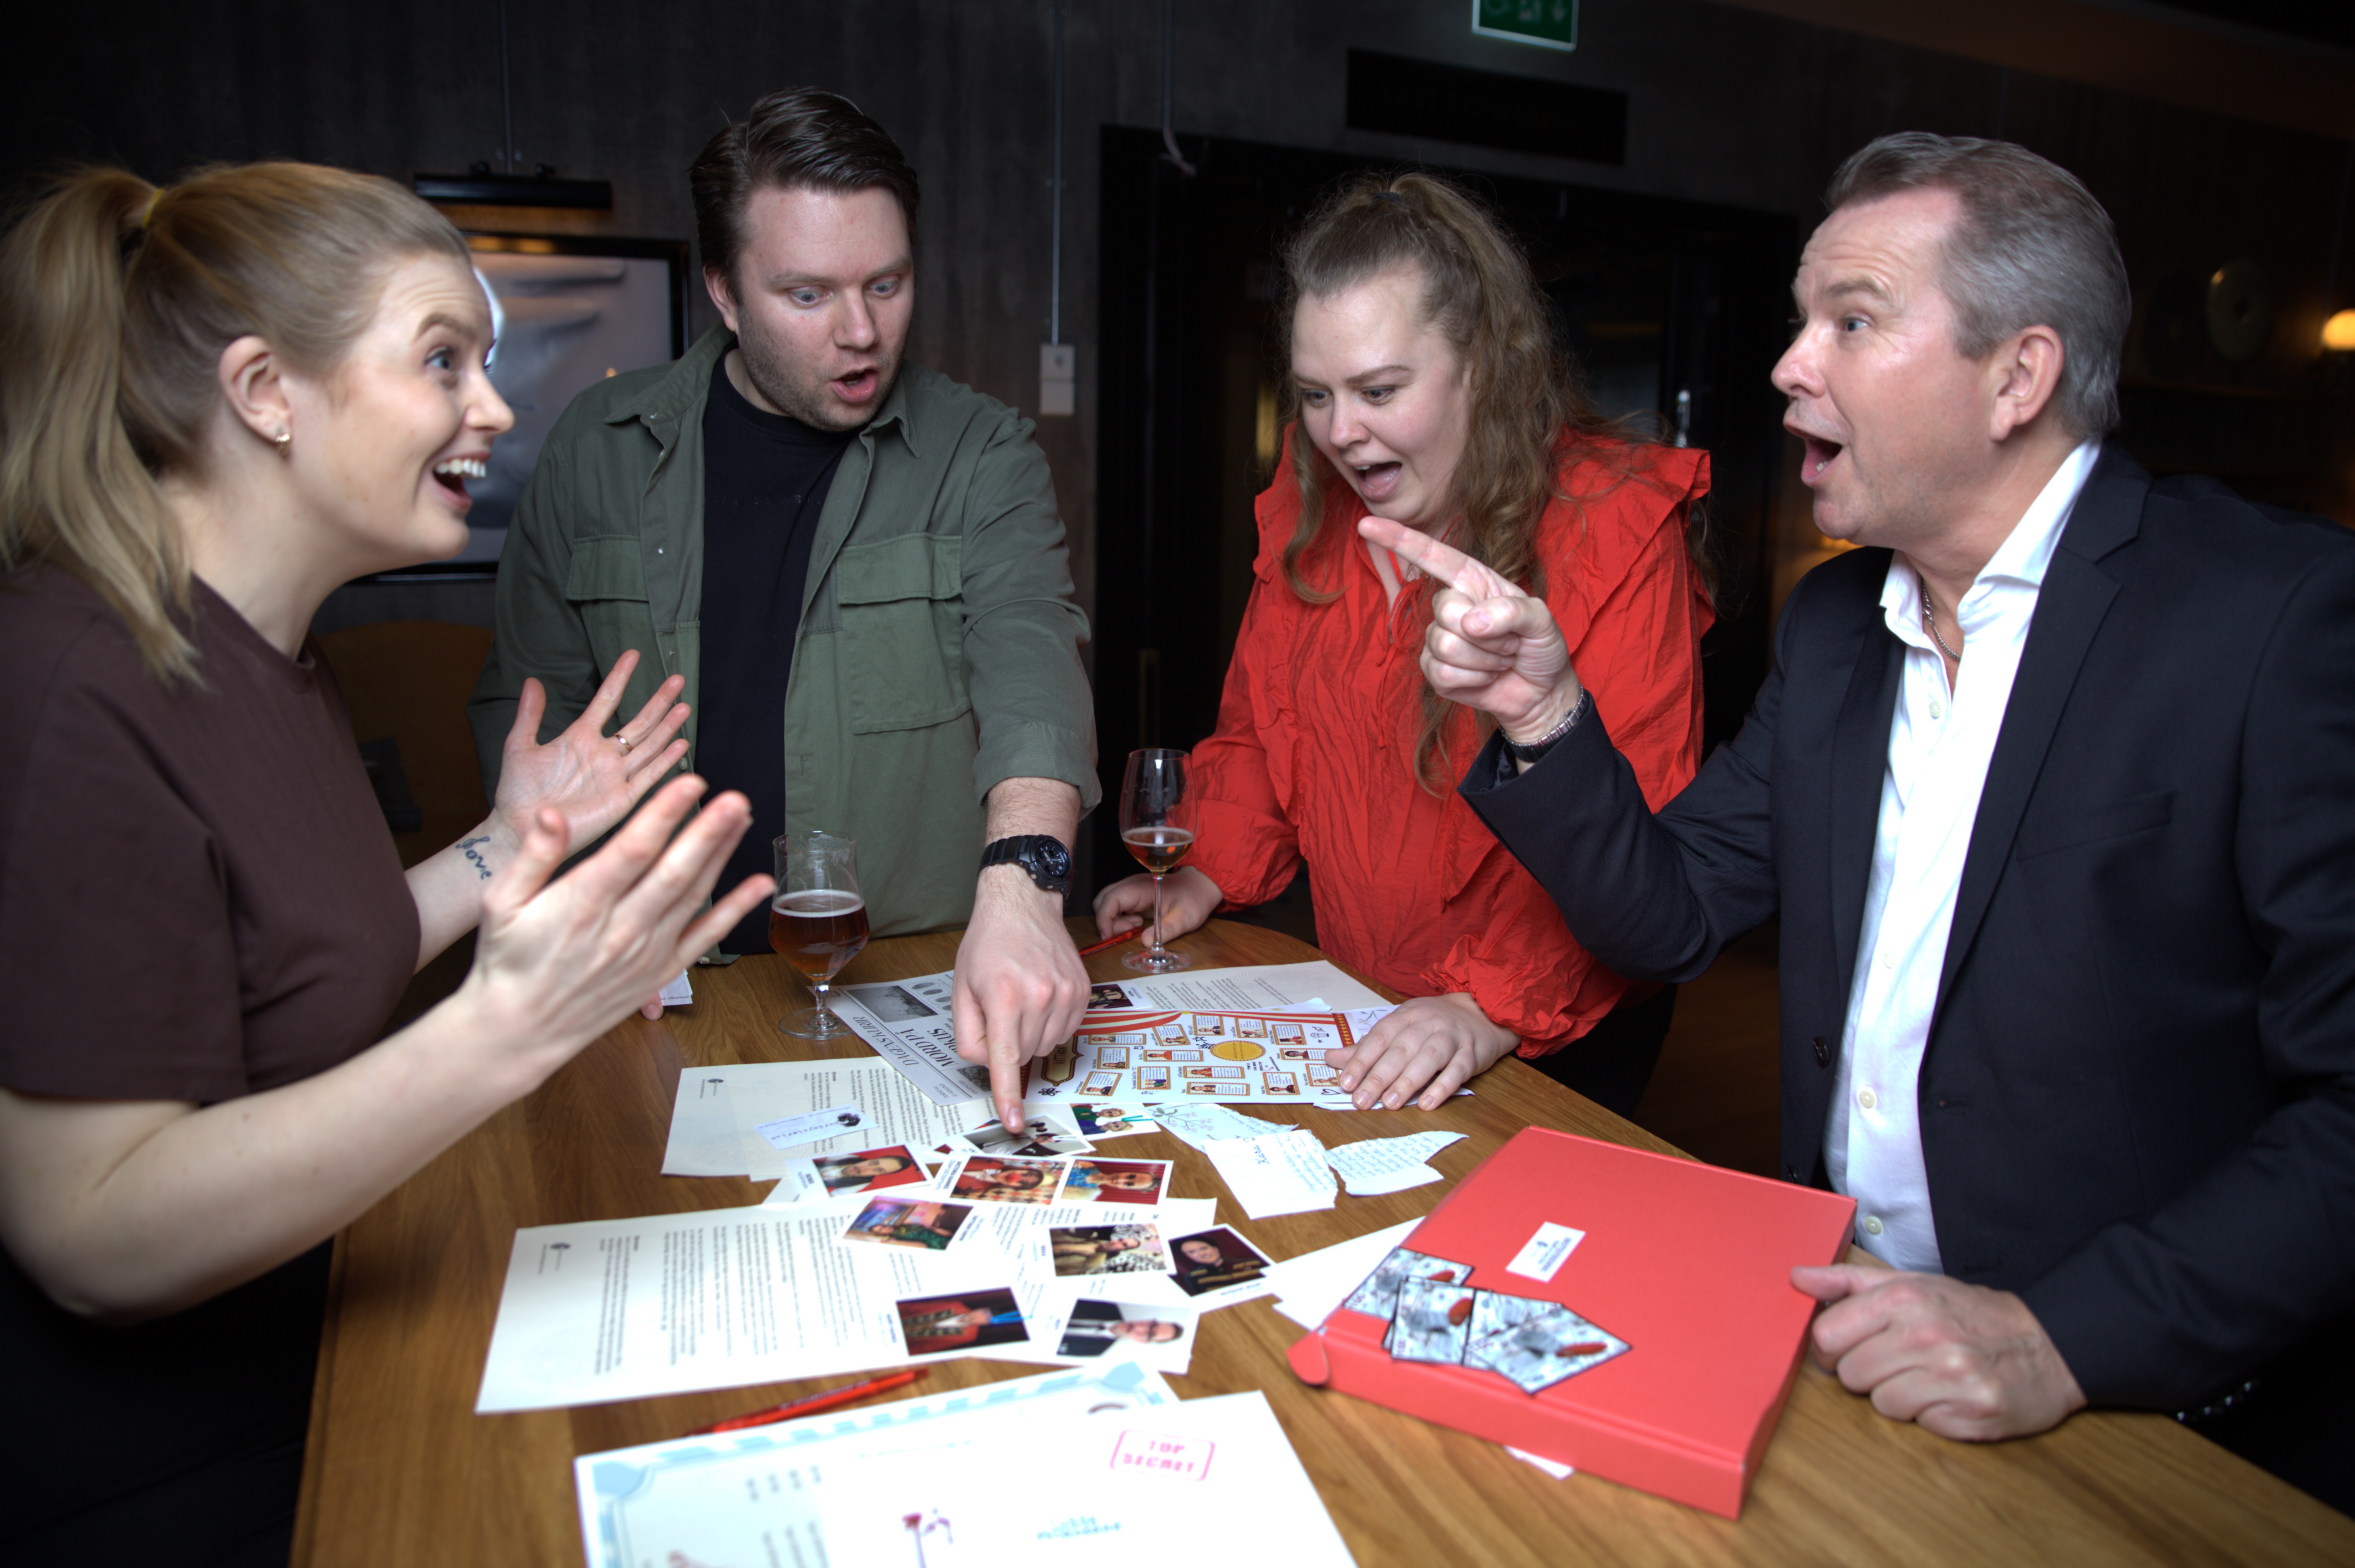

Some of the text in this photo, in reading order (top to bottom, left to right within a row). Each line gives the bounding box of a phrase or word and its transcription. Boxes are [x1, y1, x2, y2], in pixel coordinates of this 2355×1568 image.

[853, 1016, 919, 1066] DAGENS KURIR
[895, 1028, 960, 1067] MORD PÅ
[950, 1161, 963, 1176] VICTORIA
